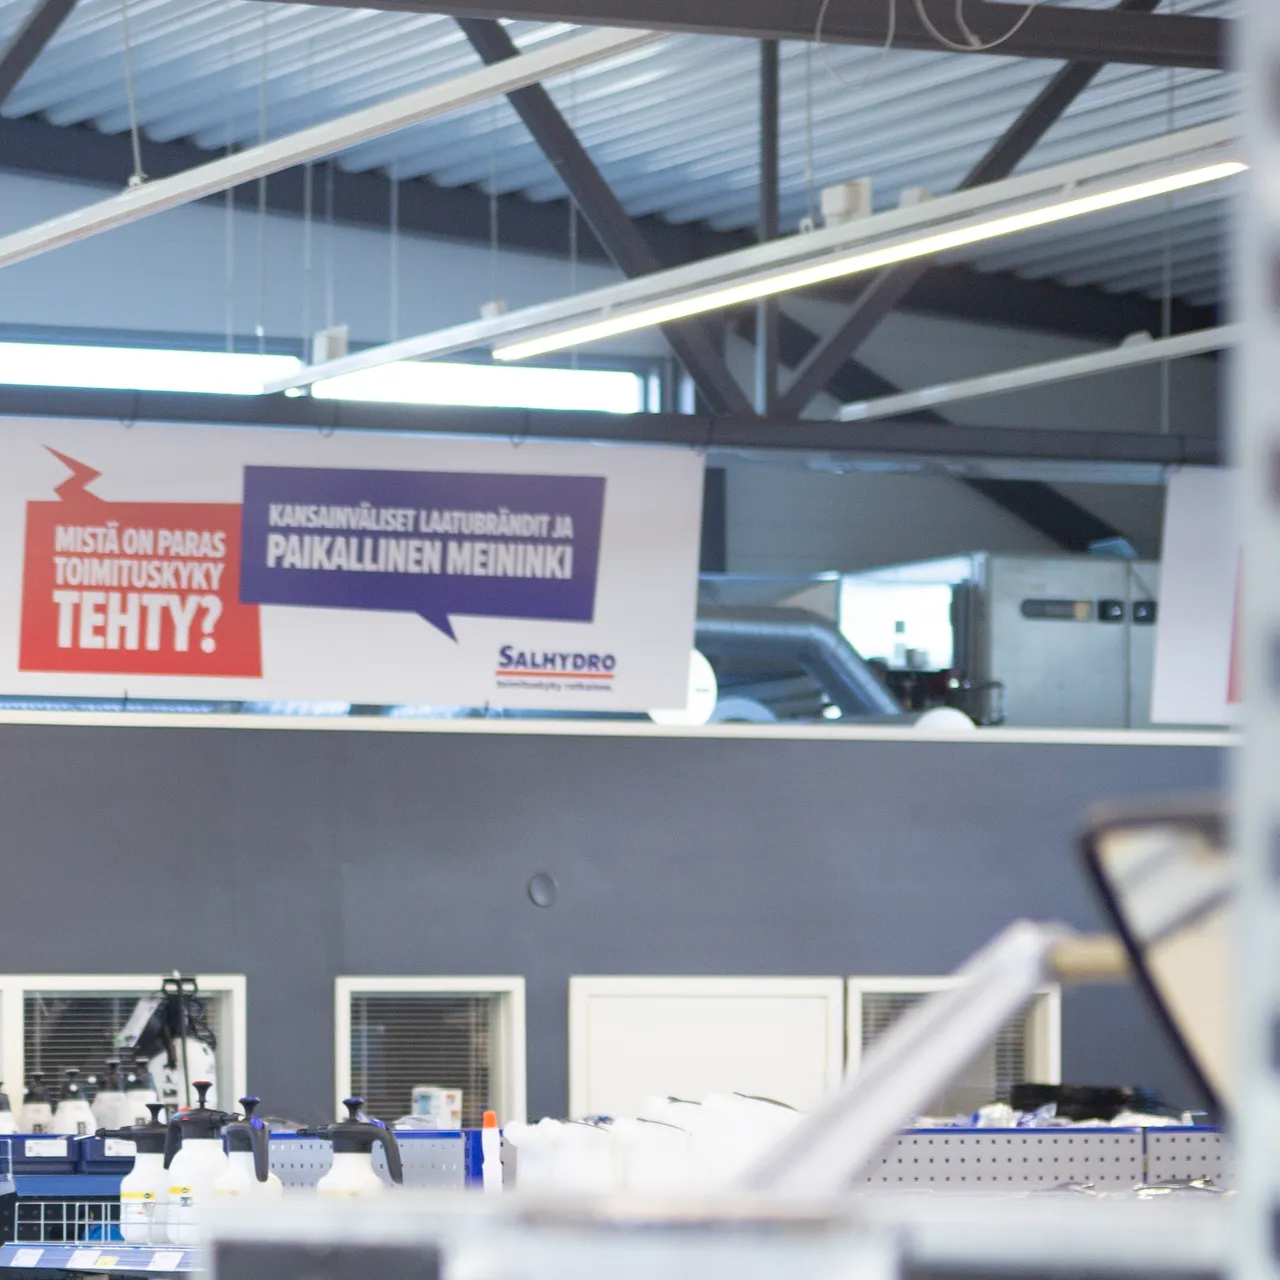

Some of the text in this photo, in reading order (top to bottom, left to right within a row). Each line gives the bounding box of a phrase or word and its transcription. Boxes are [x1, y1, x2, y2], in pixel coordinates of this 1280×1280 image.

[55, 520, 226, 558] MISTÄ ON PARAS
[269, 501, 574, 539] KANSAINVÄLISET LAATUBRÄNDIT JA
[53, 556, 225, 591] TOIMITUSKYKY
[266, 532, 574, 580] PAIKALLINEN MEININKI
[52, 589, 223, 654] TEHTY?
